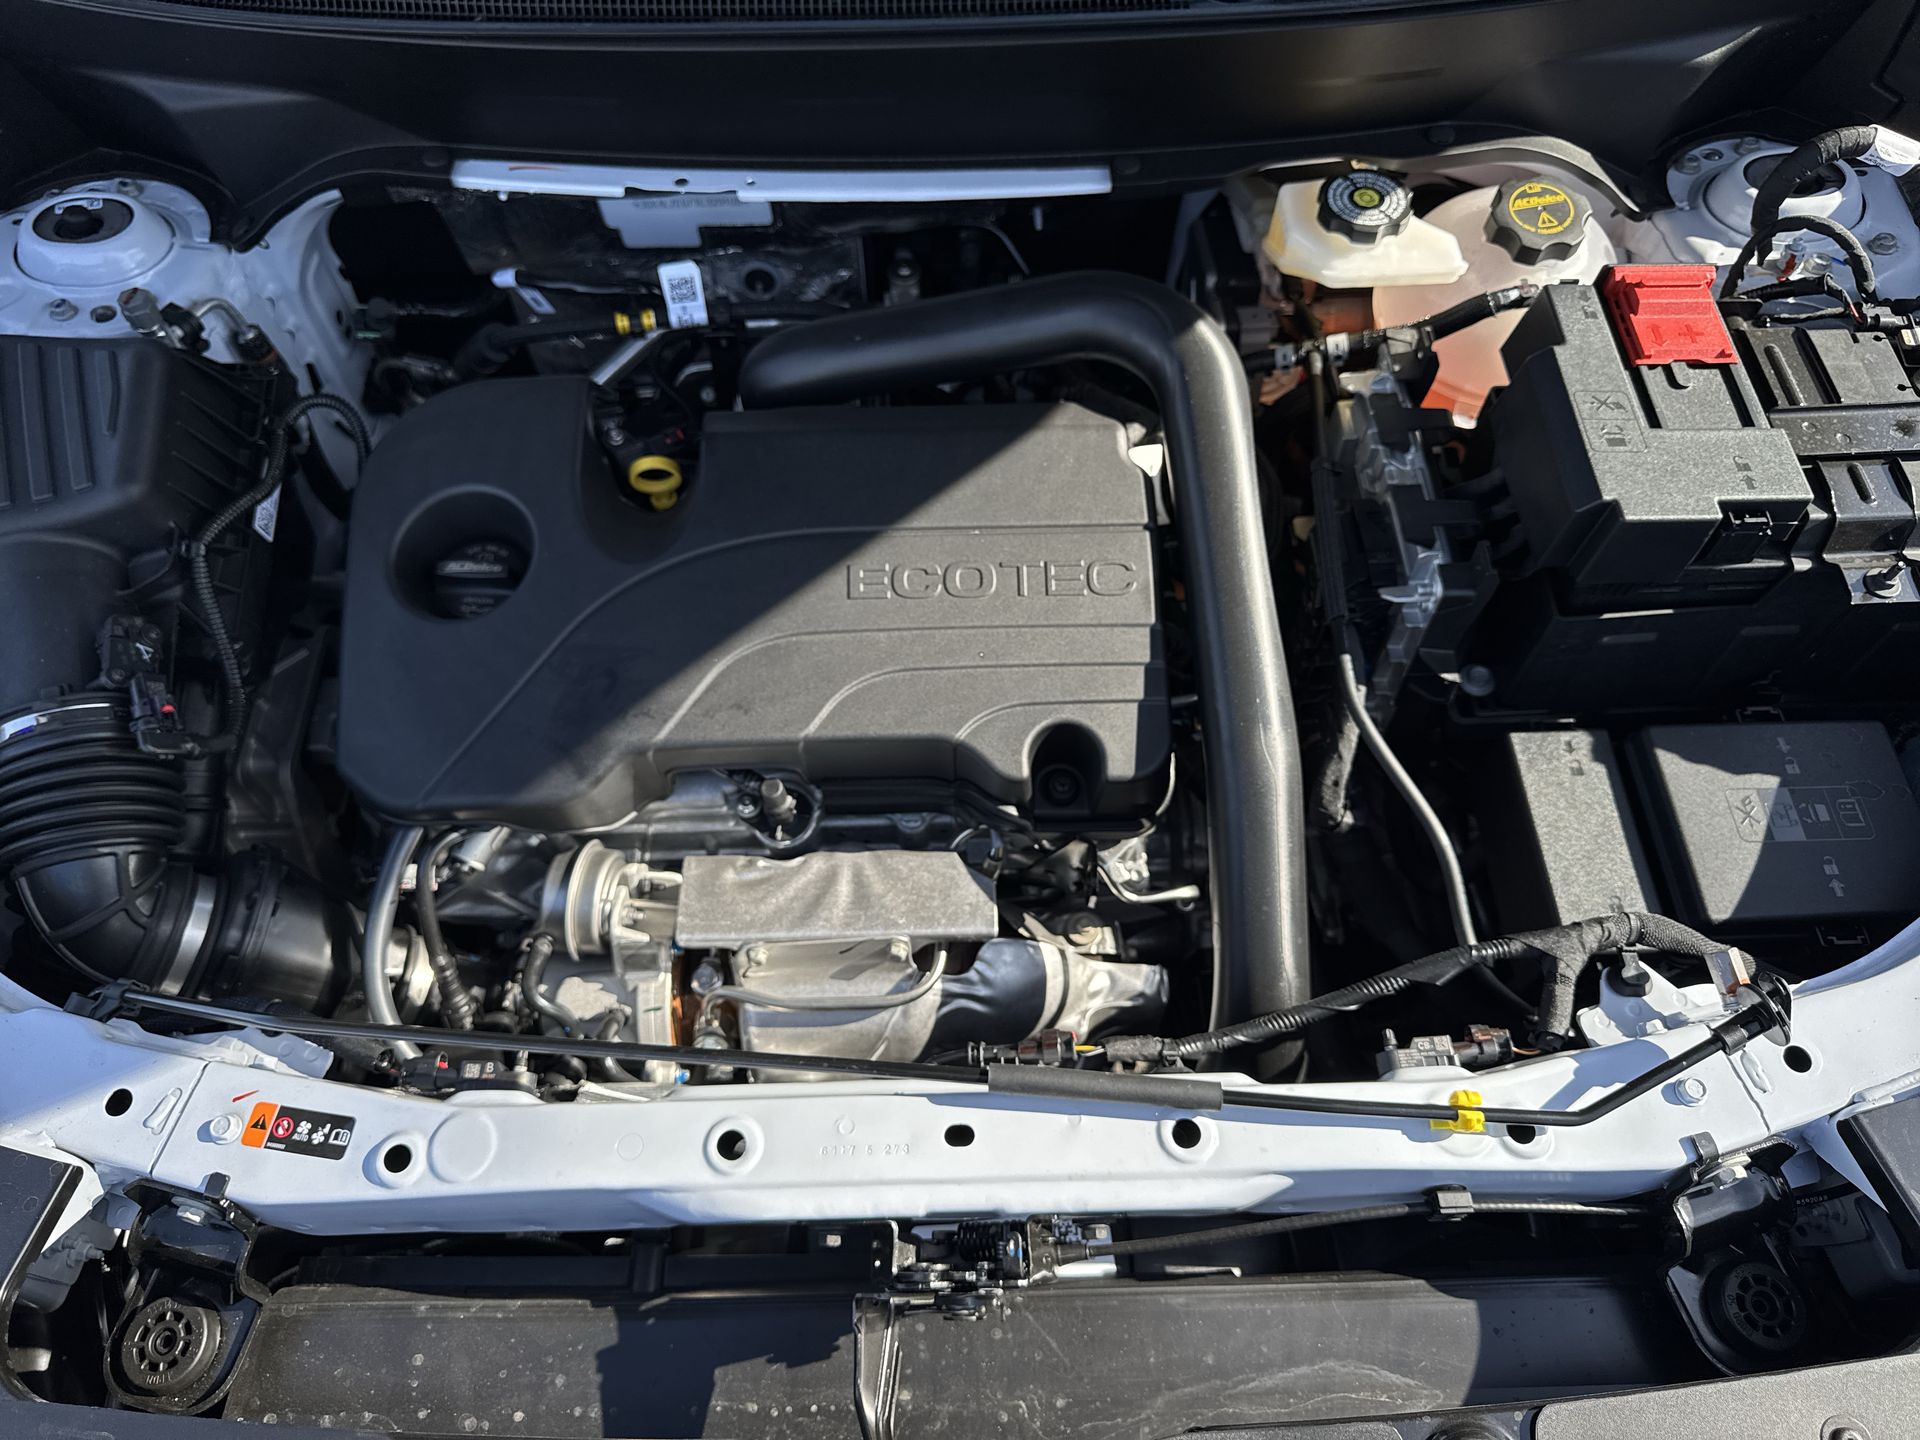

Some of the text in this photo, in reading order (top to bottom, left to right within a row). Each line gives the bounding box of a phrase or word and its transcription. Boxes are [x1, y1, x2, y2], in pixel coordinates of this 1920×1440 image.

[444, 561, 503, 573] ACDelco
[846, 560, 1138, 600] ECOTEC
[486, 1061, 495, 1073] B
[291, 1132, 309, 1142] AUTO
